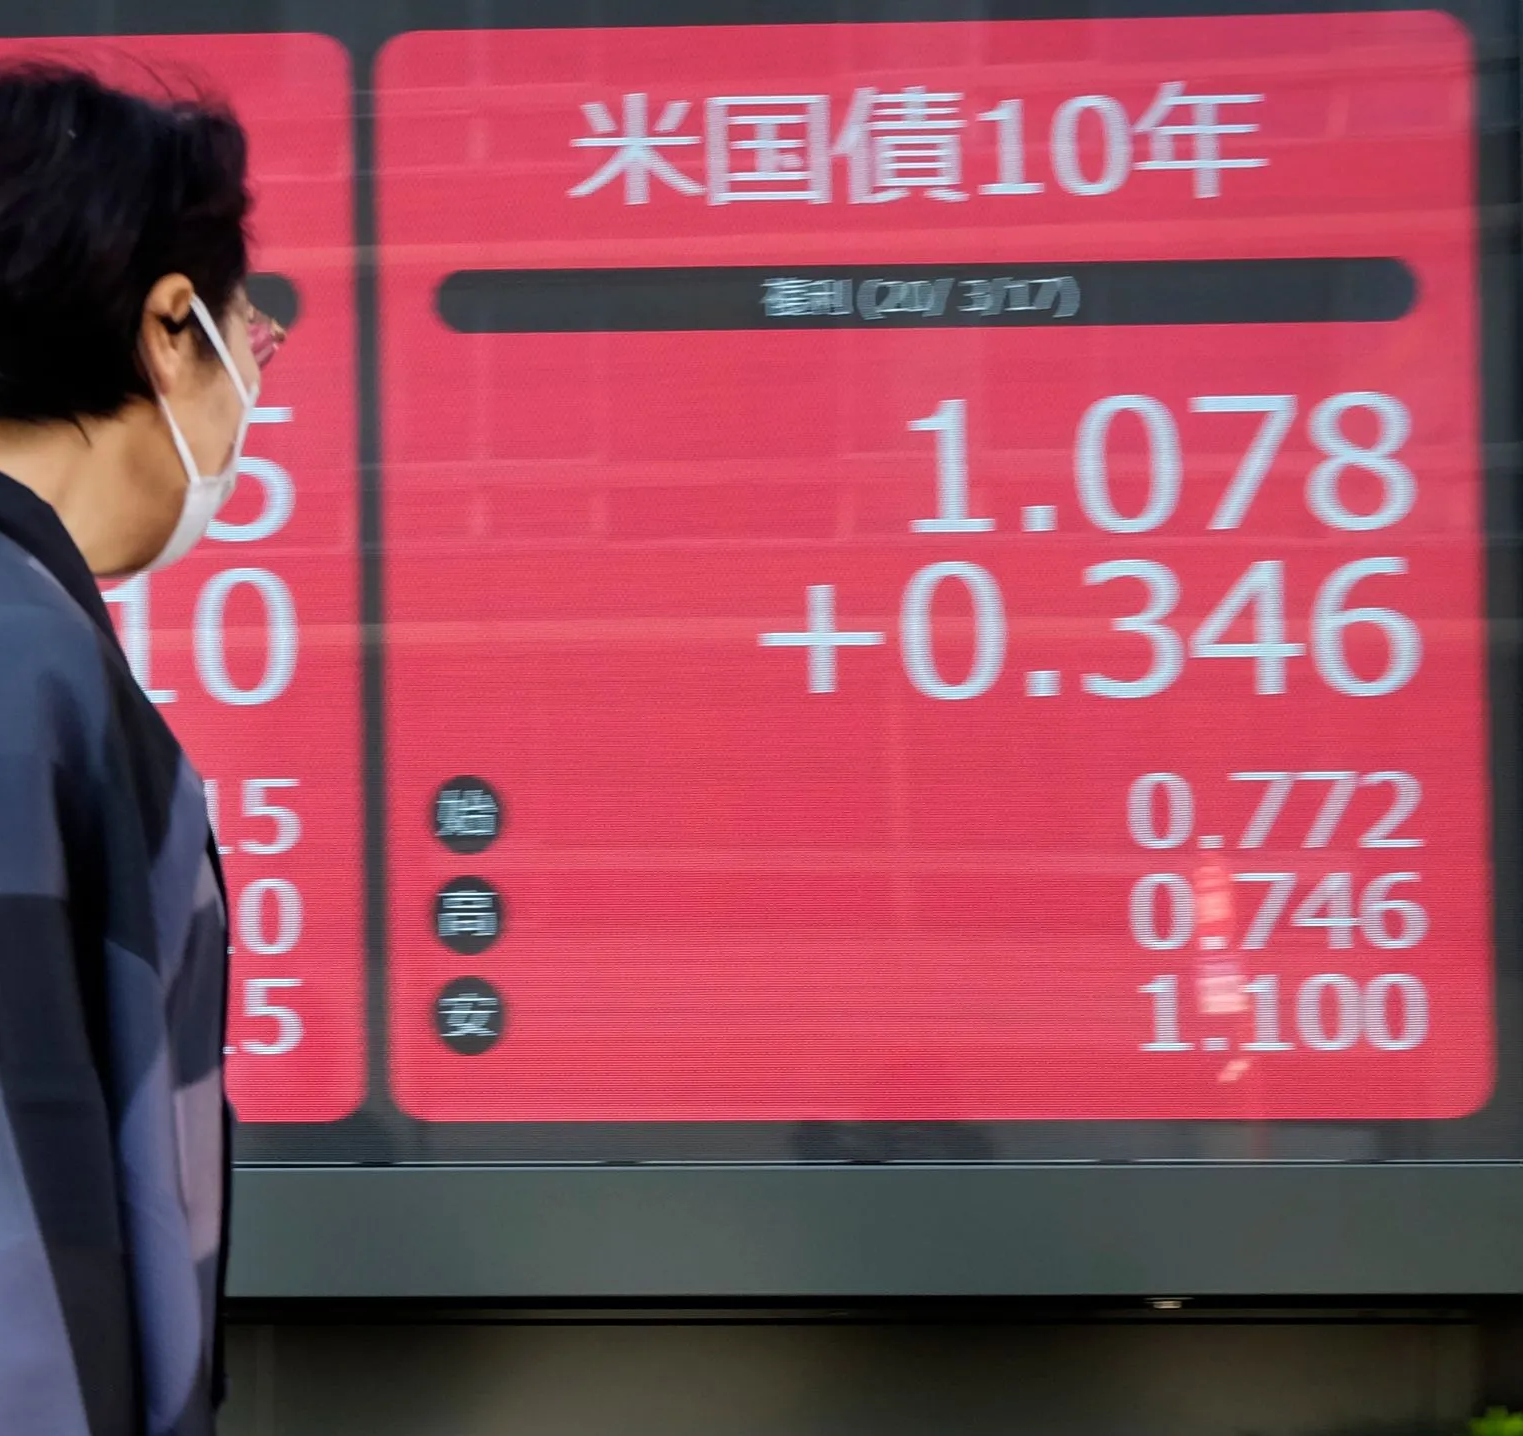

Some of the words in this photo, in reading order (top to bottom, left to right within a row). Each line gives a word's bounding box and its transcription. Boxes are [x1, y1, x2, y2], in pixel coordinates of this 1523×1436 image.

[567, 82, 1269, 206] 米国債10年
[906, 391, 1419, 535] 1.078
[758, 556, 1423, 702] +0.346
[1127, 771, 1426, 851] 0.772
[437, 890, 500, 937] 高
[1129, 871, 1430, 952] 0.746
[439, 991, 500, 1037] 安
[1139, 973, 1430, 1054] 1.100
